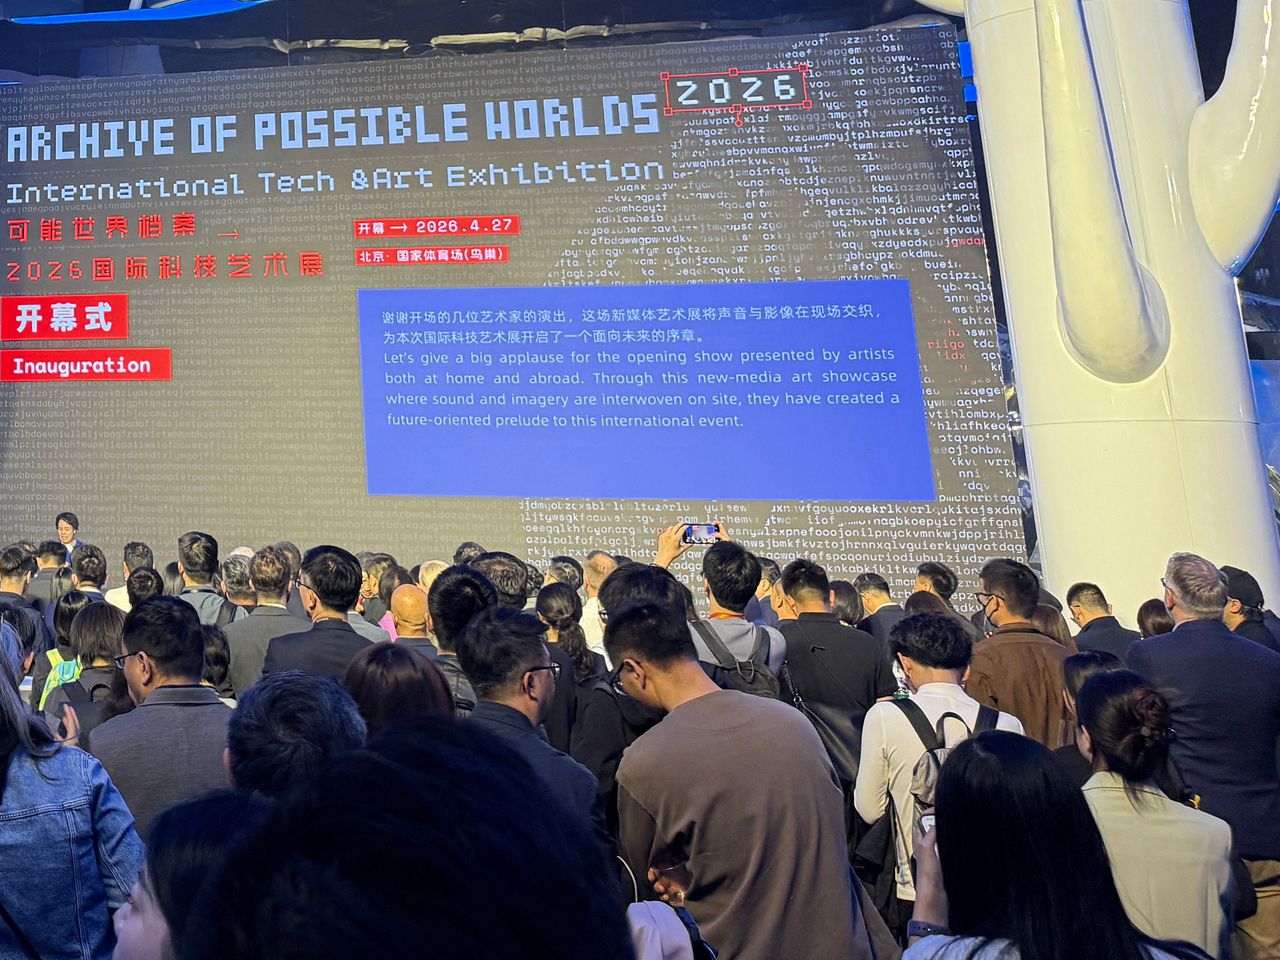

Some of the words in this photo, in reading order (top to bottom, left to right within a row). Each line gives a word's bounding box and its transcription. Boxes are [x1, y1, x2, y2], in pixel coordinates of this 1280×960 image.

[676, 73, 797, 106] 2026
[7, 118, 174, 162] ARCHIVE
[191, 114, 237, 153] OF
[255, 104, 469, 151] POSSIBLE
[486, 93, 661, 141] WORLDS
[6, 172, 245, 204] International
[258, 169, 335, 194] Tech
[351, 167, 434, 191] &Art
[447, 158, 665, 188] Exhibition
[6, 212, 197, 244] 可能世界档案
[358, 221, 385, 236] 开幕
[416, 217, 514, 234] 2026.4.27
[6, 250, 325, 282] 2026国际科技艺术展
[15, 302, 113, 333] 开幕式
[13, 356, 151, 378] Inauguration
[384, 352, 414, 364] Let's
[420, 352, 448, 366] give
[470, 351, 492, 366] big
[499, 351, 564, 366] applause
[570, 351, 590, 363] for
[597, 351, 620, 363] the
[627, 350, 687, 365] opening
[694, 350, 733, 362] show
[740, 349, 815, 364] presented
[822, 348, 841, 363] by
[848, 348, 895, 360] artists
[385, 372, 416, 385] both
[424, 373, 438, 385] at
[446, 372, 485, 385] home
[493, 372, 520, 385] and
[529, 372, 585, 385] abroad.
[593, 371, 653, 386] Through
[662, 371, 688, 384] this
[697, 370, 782, 384] new-media
[791, 371, 813, 383] art
[822, 369, 897, 382] showcase
[385, 393, 428, 406] where
[432, 393, 474, 406] sound
[479, 393, 506, 406] and
[511, 393, 569, 408] imagery
[574, 395, 597, 406] are
[601, 393, 683, 406] interwoven
[688, 395, 706, 406] on
[712, 393, 742, 407] site,
[747, 392, 780, 407] they
[785, 392, 821, 405] have
[827, 391, 884, 404] created
[387, 414, 491, 427] future-oriented
[496, 413, 549, 428] prelude
[553, 415, 567, 427] to
[571, 413, 597, 427] this
[601, 414, 694, 427] international
[699, 415, 744, 427] event.
